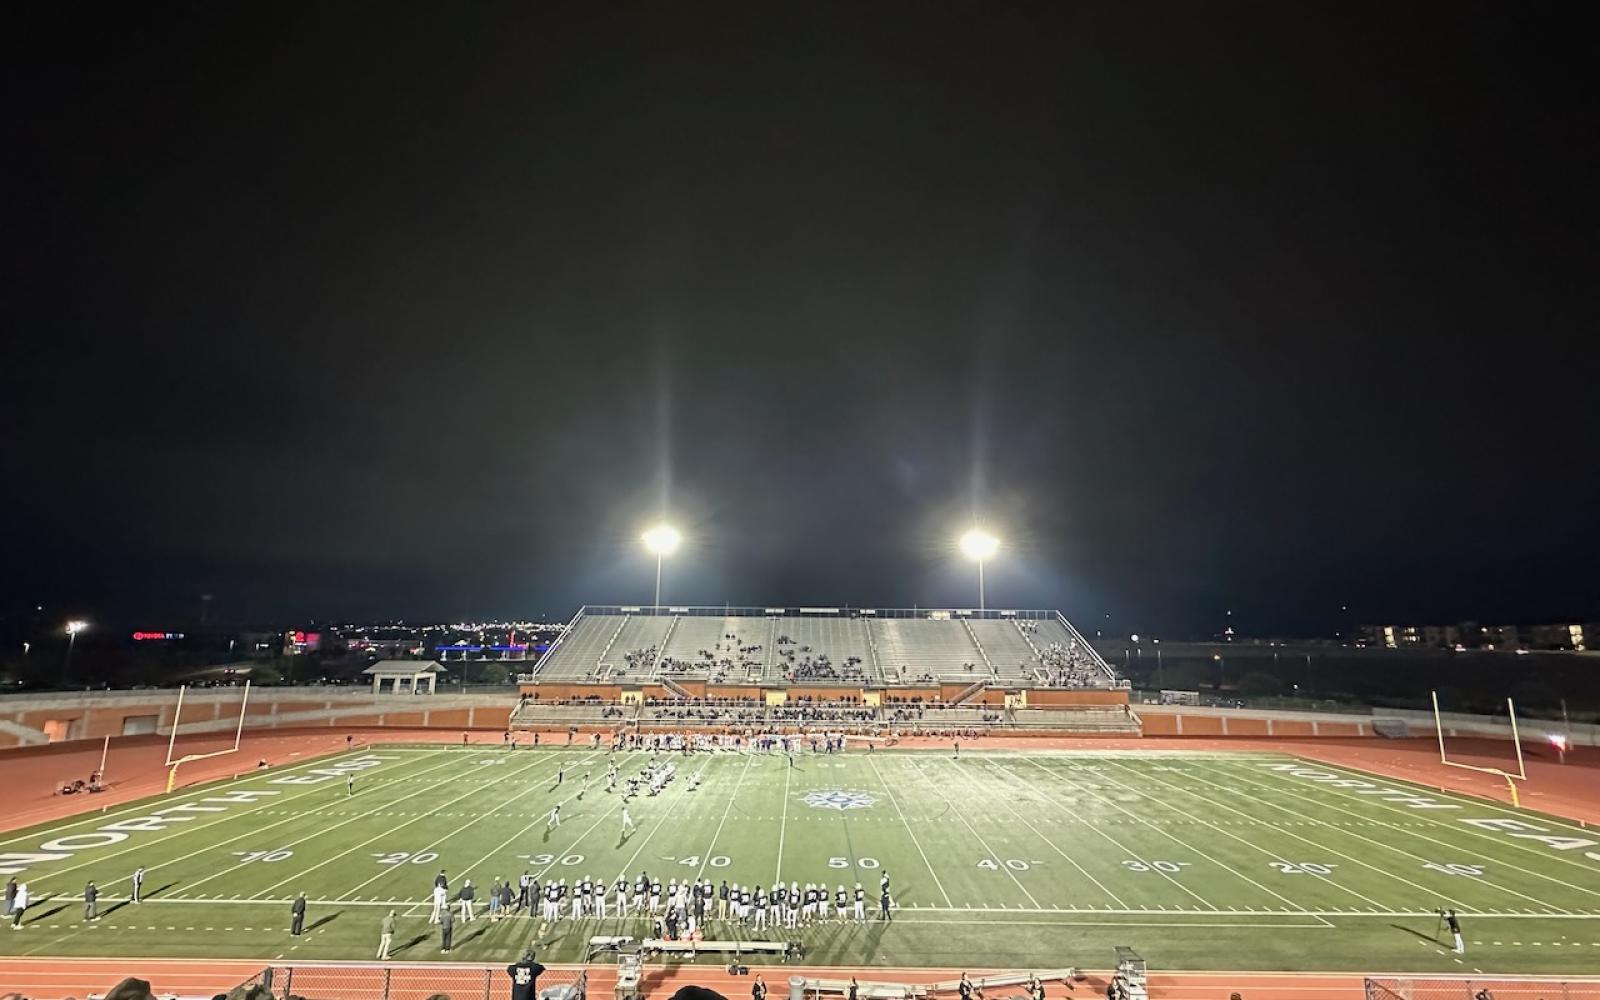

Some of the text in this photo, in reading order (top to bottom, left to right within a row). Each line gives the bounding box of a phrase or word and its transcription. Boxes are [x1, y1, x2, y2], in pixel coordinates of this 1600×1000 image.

[0, 754, 400, 874] NORTH EAST
[1256, 763, 1600, 861] NORTH EA
[240, 850, 293, 862] 10
[376, 852, 439, 865] 20
[529, 854, 585, 866] 30
[678, 855, 731, 868] 40
[828, 856, 880, 869] 50
[977, 859, 1030, 871] 40
[1121, 860, 1180, 872] 30
[1268, 861, 1331, 874] 20
[1422, 862, 1484, 875] 10
